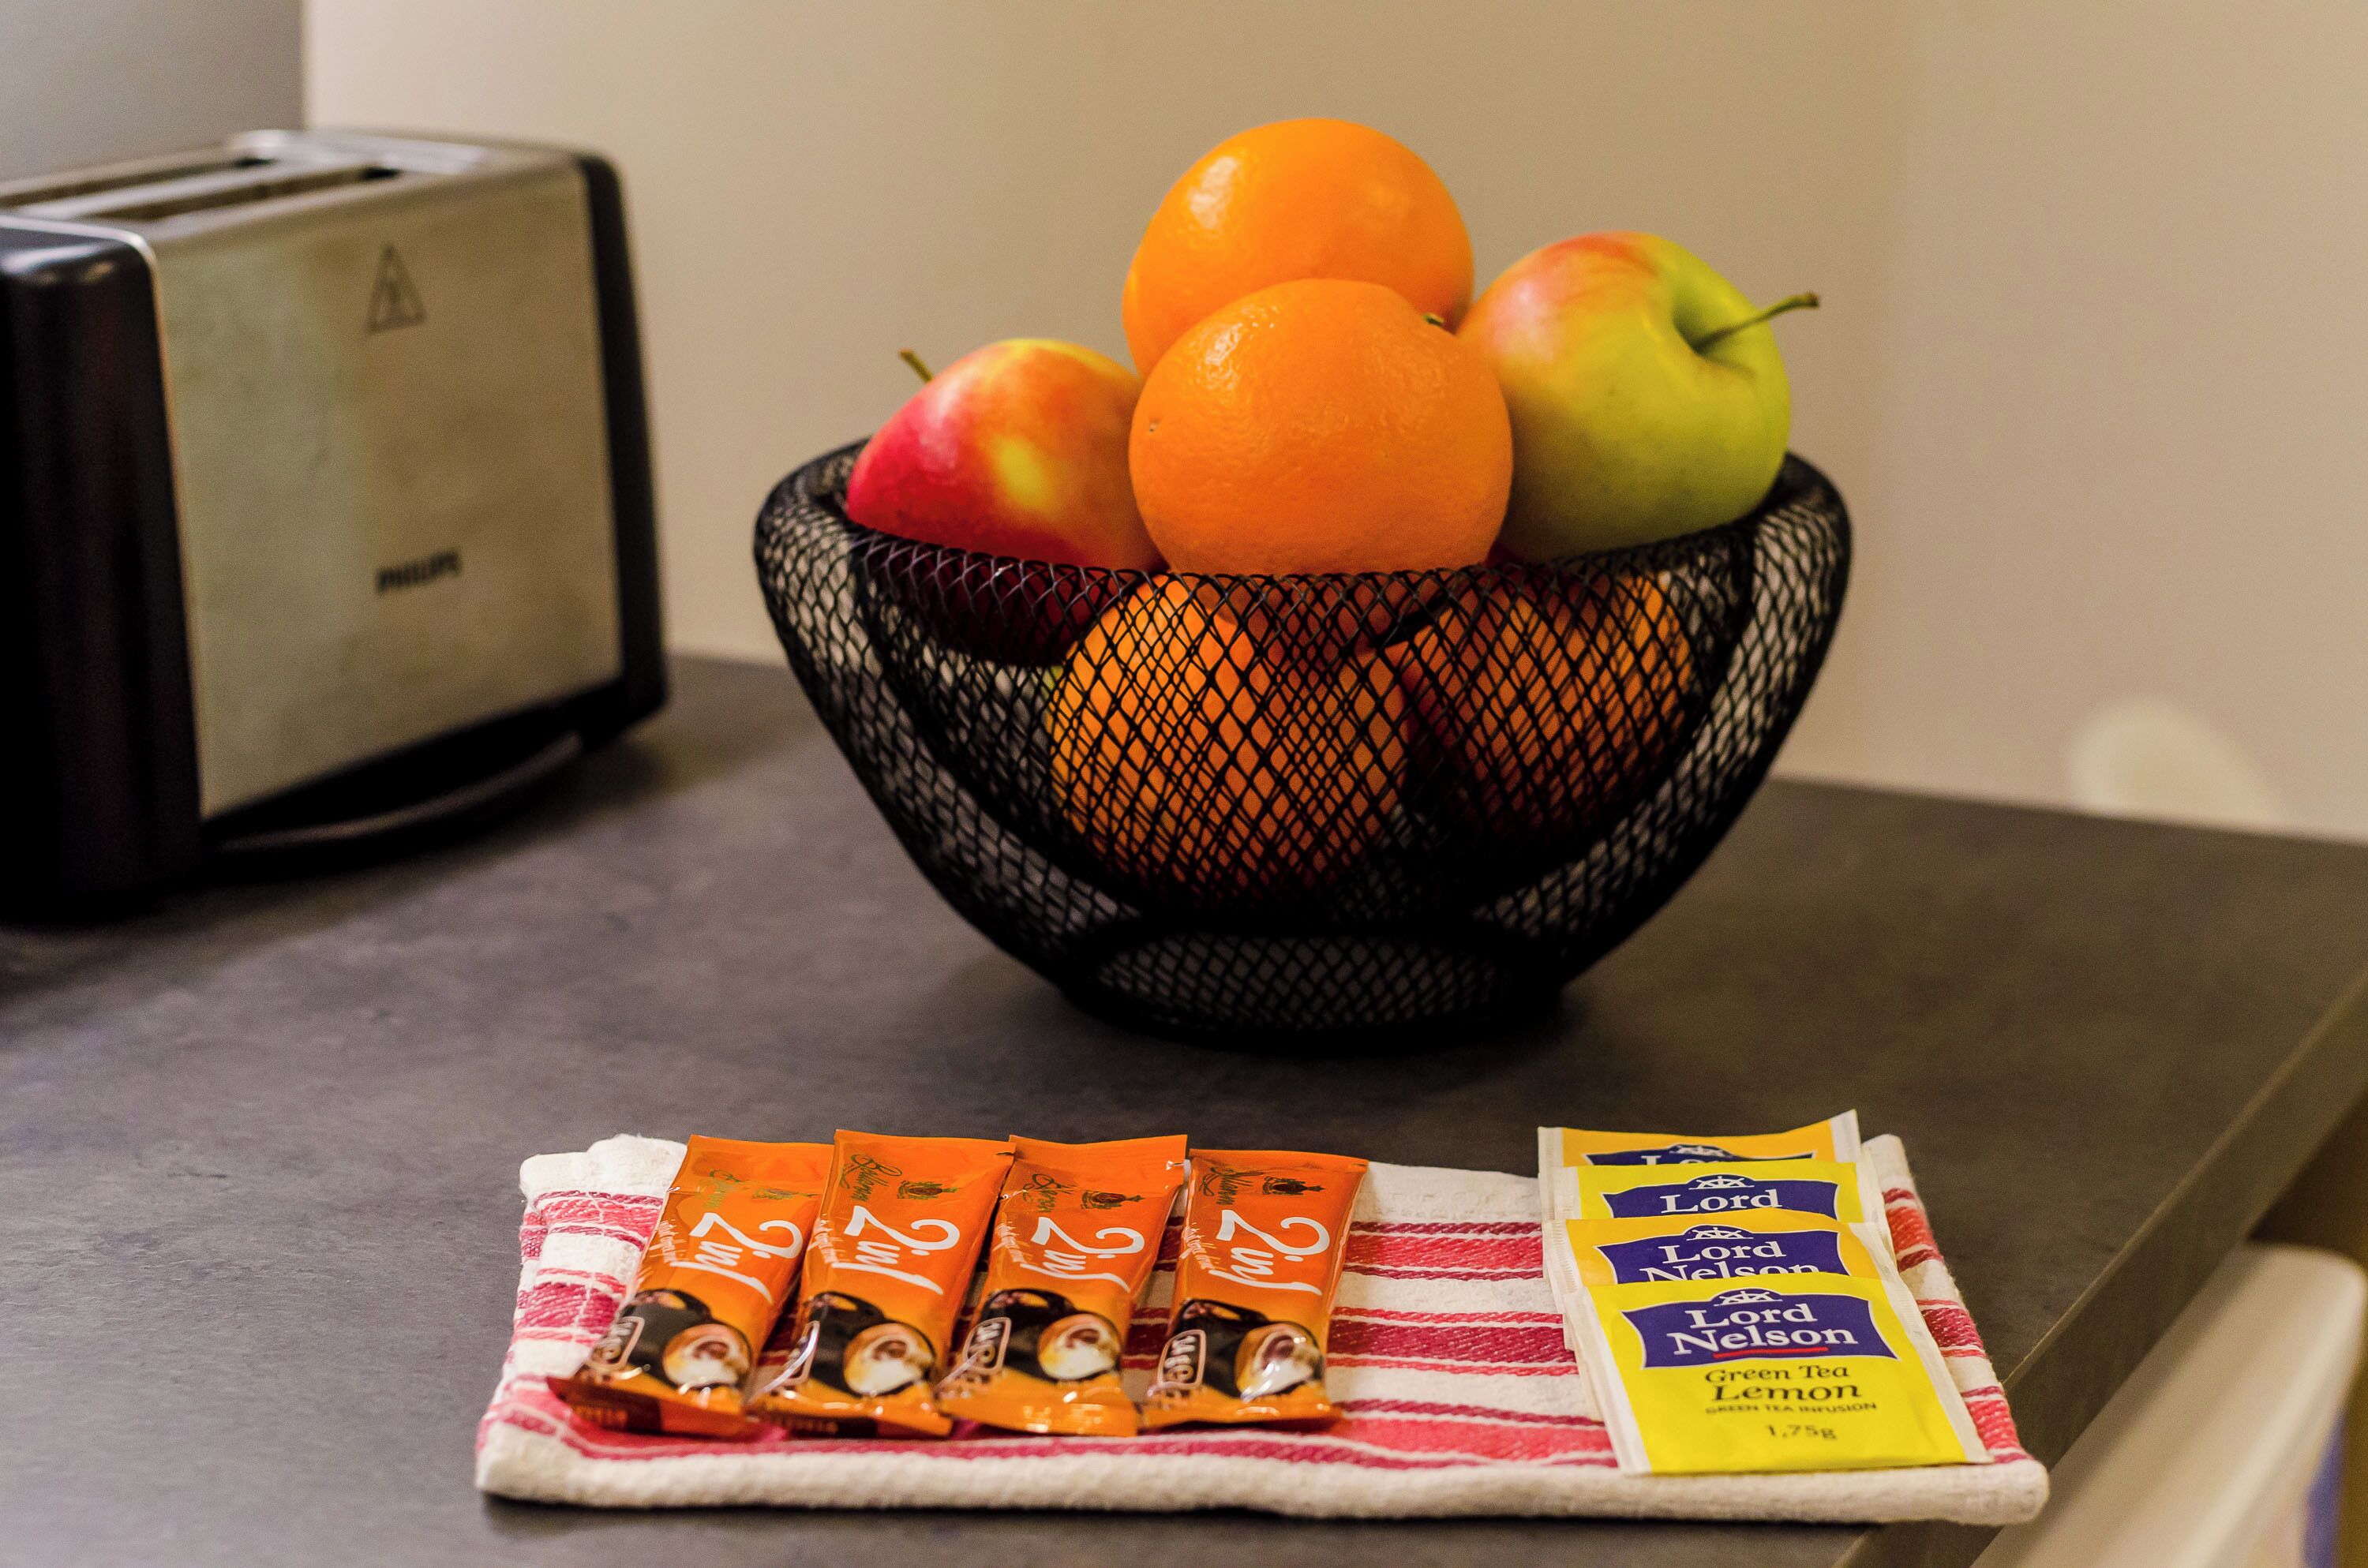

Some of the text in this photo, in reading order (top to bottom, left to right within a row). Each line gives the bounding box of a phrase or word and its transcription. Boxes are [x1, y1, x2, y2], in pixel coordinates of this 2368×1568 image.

[1660, 1188, 1782, 1213] Lord
[1658, 1241, 1787, 1263] Lord
[1685, 1304, 1818, 1329] Lord
[1666, 1325, 1859, 1356] Nelson
[1705, 1364, 1849, 1383] Green Tea
[1712, 1383, 1863, 1401] Lemon
[1705, 1401, 1877, 1414] GREEN TEA INFUSION
[1766, 1424, 1838, 1441] 1,75g
